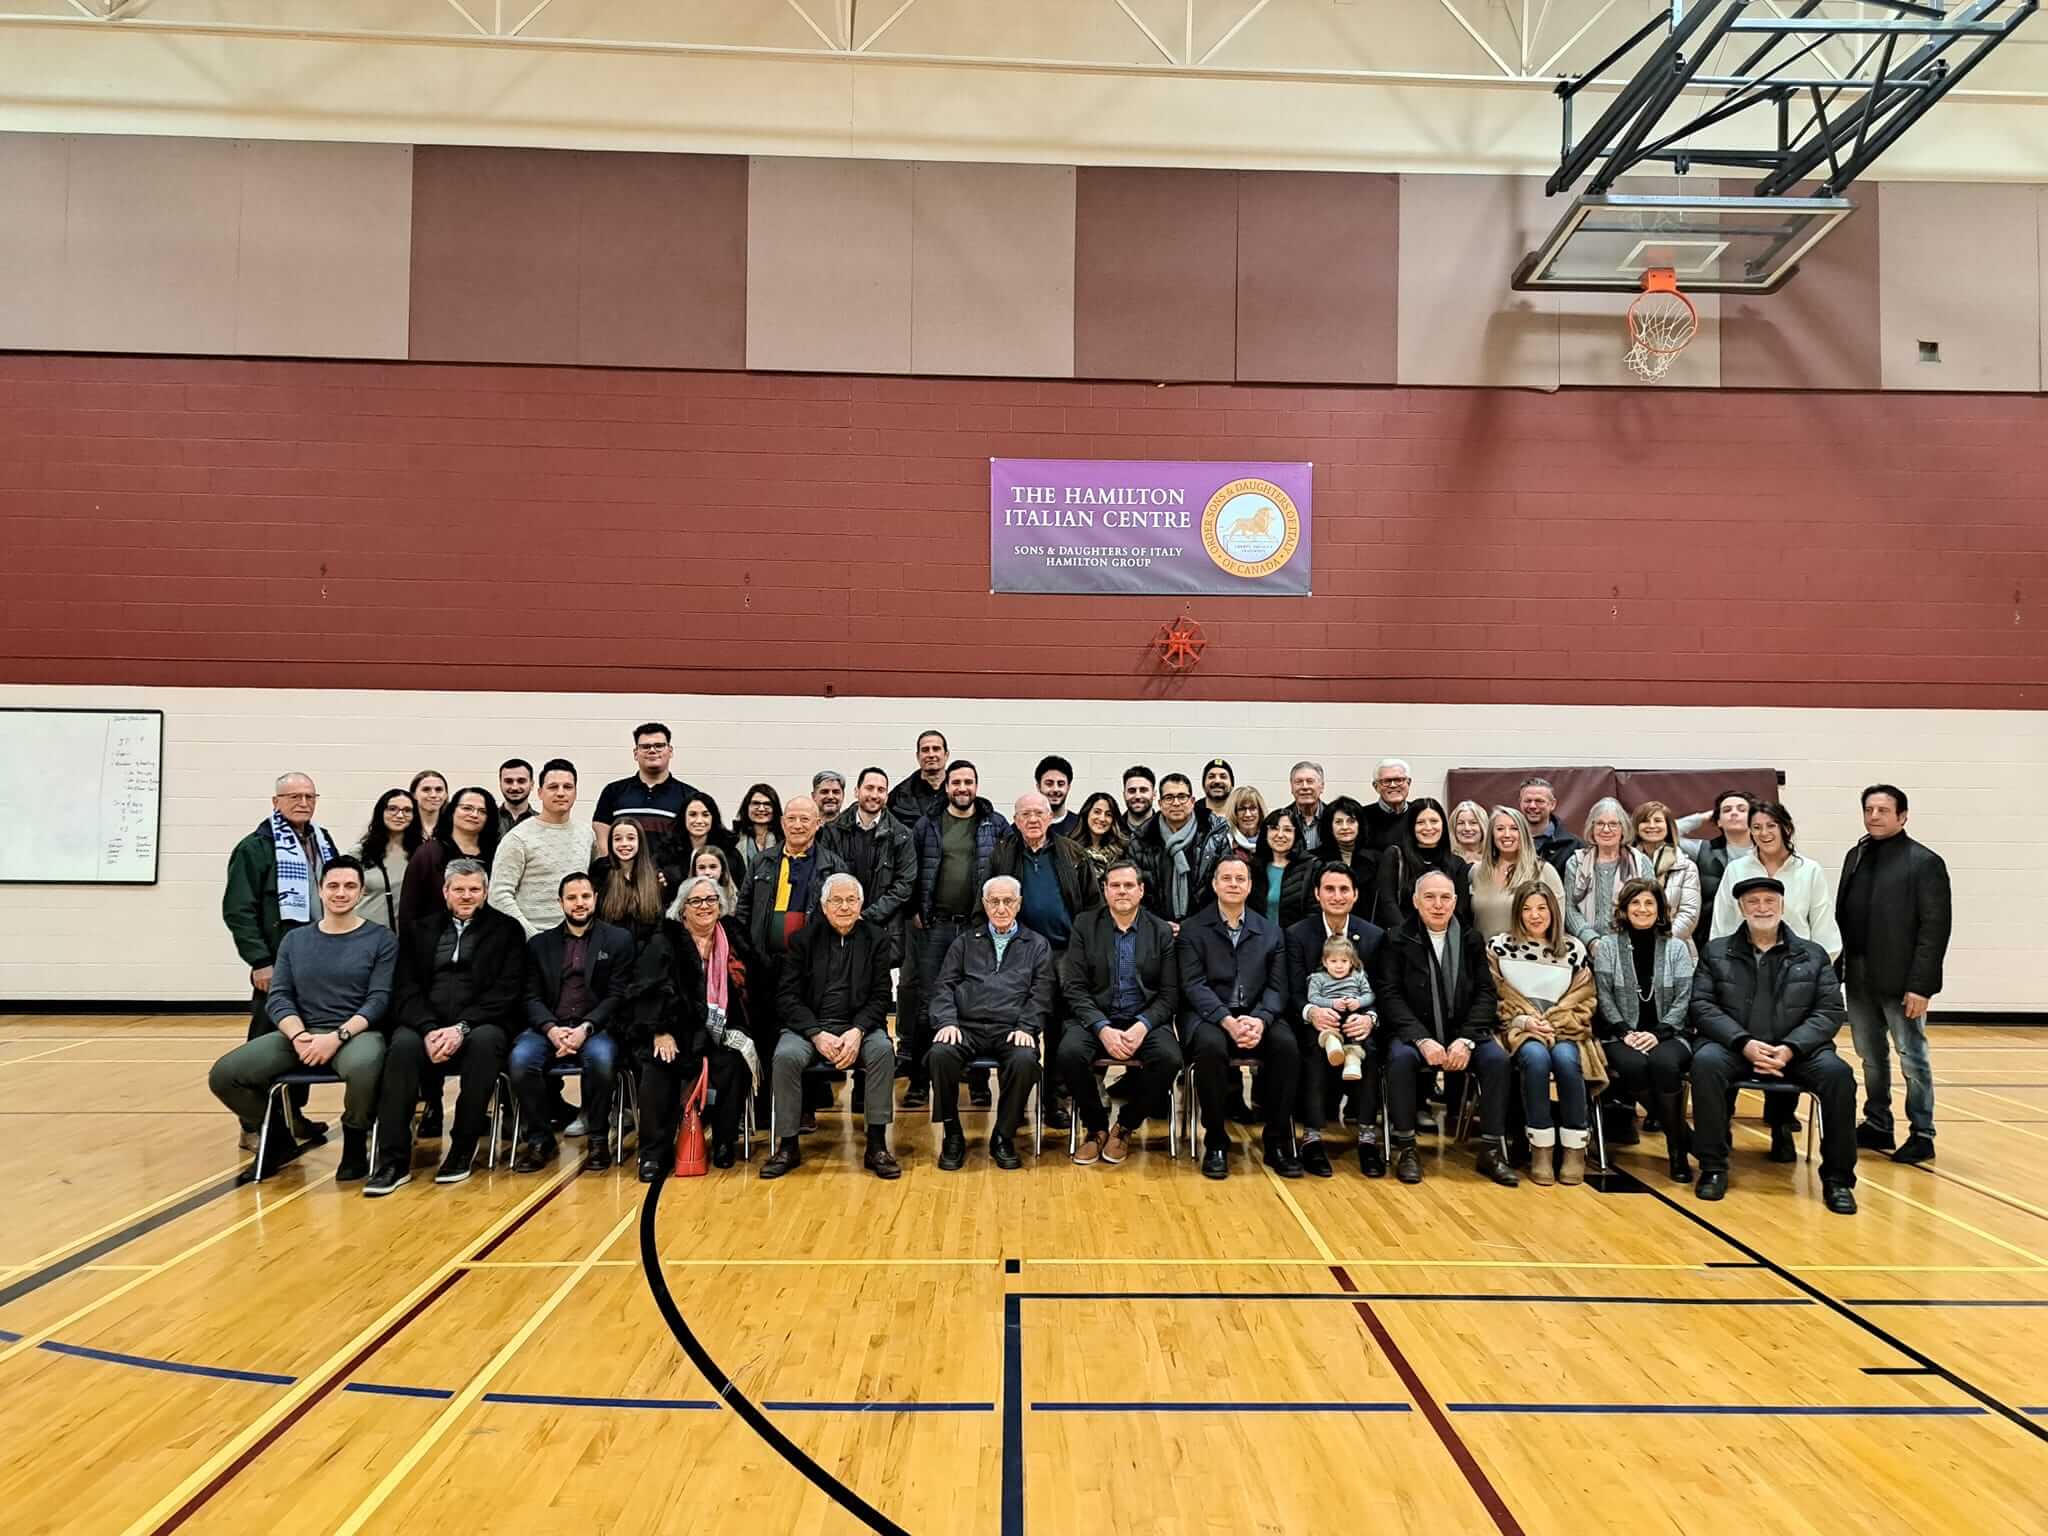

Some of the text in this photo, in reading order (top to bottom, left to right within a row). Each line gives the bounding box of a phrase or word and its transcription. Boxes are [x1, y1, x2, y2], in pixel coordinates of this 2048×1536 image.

[1011, 486, 1185, 505] THE HAMILTON
[1235, 481, 1289, 511] DAUGHTERS
[1207, 493, 1226, 518] SONS
[1004, 509, 1192, 529] ITALIAN CENTRE
[1286, 511, 1297, 526] OF
[1204, 520, 1218, 554] ORDER
[1284, 527, 1297, 555] ITALY
[1014, 545, 1183, 557] SONS & DAUGHTERS OF ITALY
[1046, 557, 1152, 568] HAMILTON GROUP
[1222, 558, 1281, 574] OF CANADA
